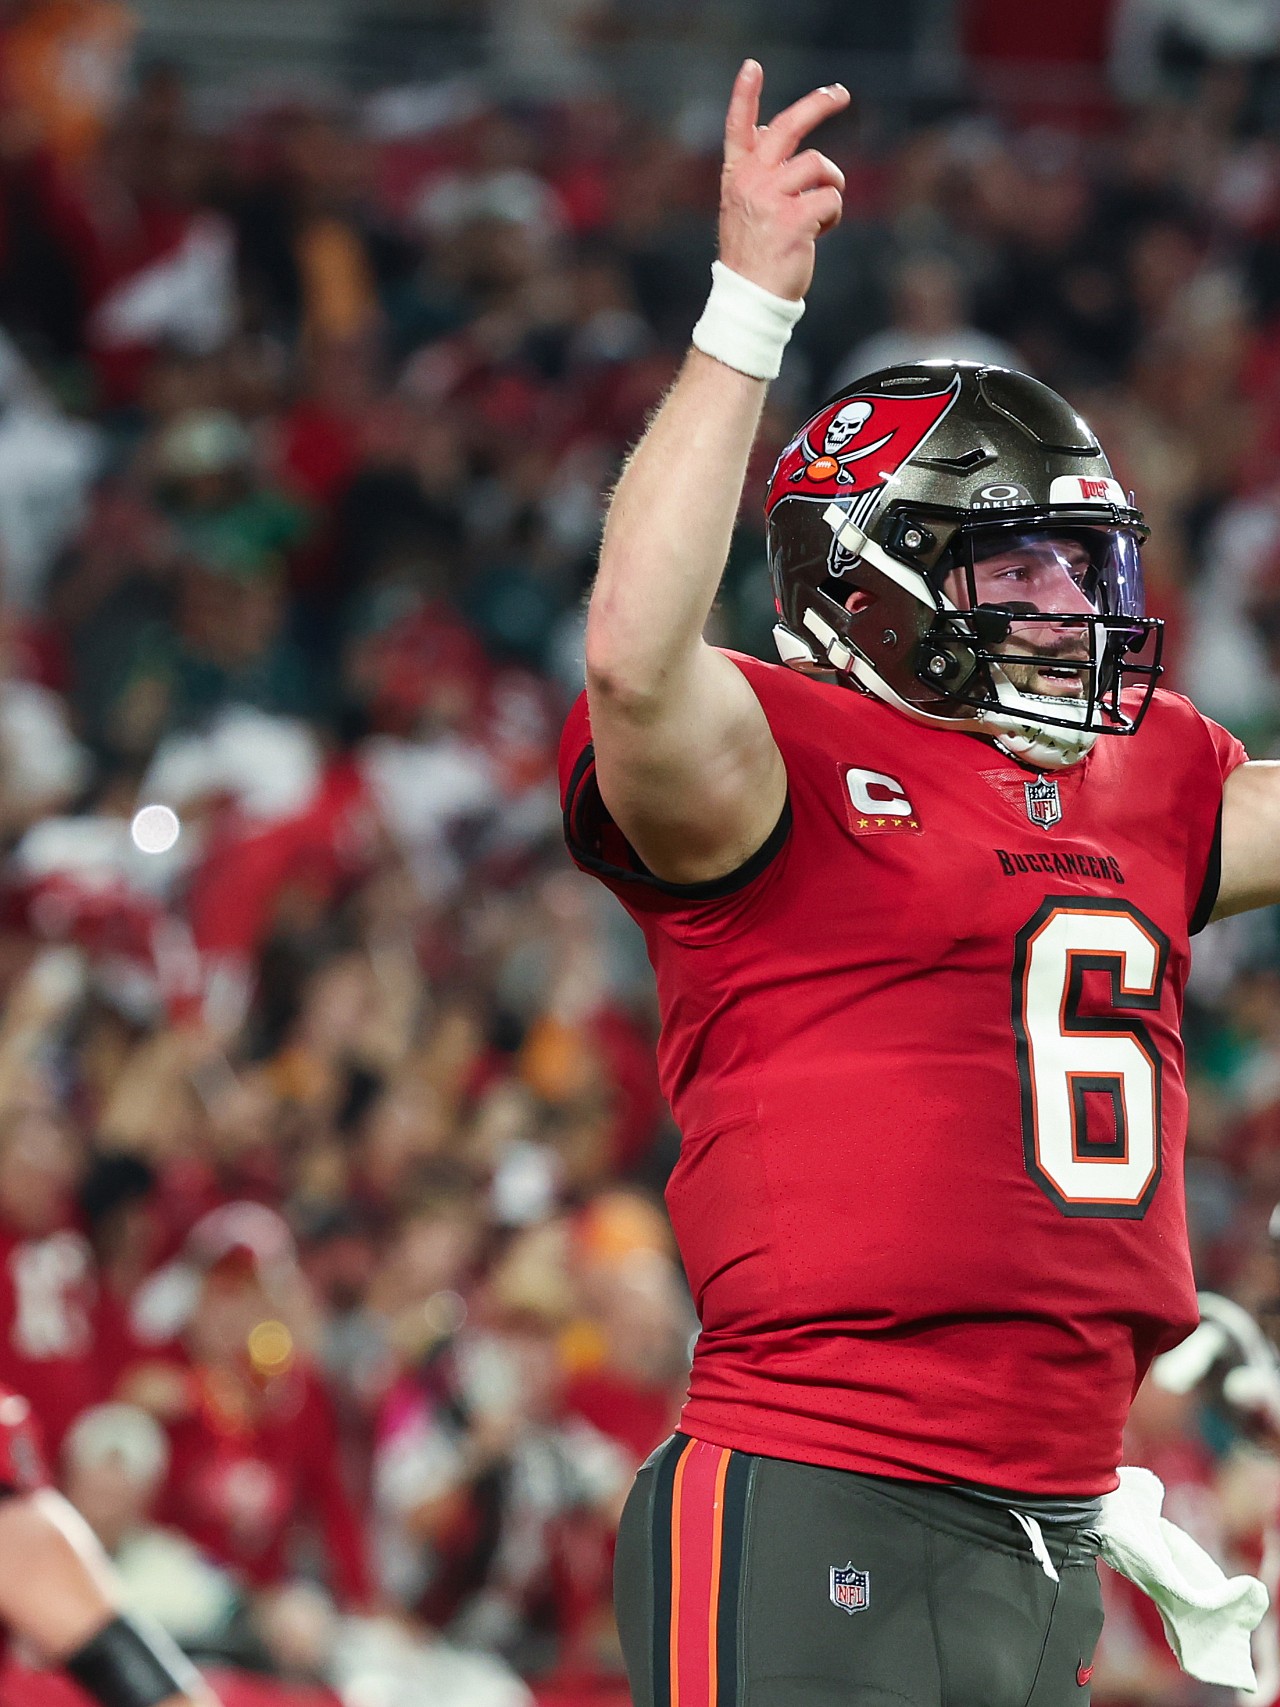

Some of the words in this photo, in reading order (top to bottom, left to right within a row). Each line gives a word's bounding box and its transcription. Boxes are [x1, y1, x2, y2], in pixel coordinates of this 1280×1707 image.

[972, 499, 1028, 510] OAKLEY
[846, 768, 912, 816] C
[1033, 800, 1056, 821] NFL
[994, 849, 1125, 884] BUCCANEERS
[1011, 895, 1169, 1220] 6
[837, 1585, 864, 1606] NFL
